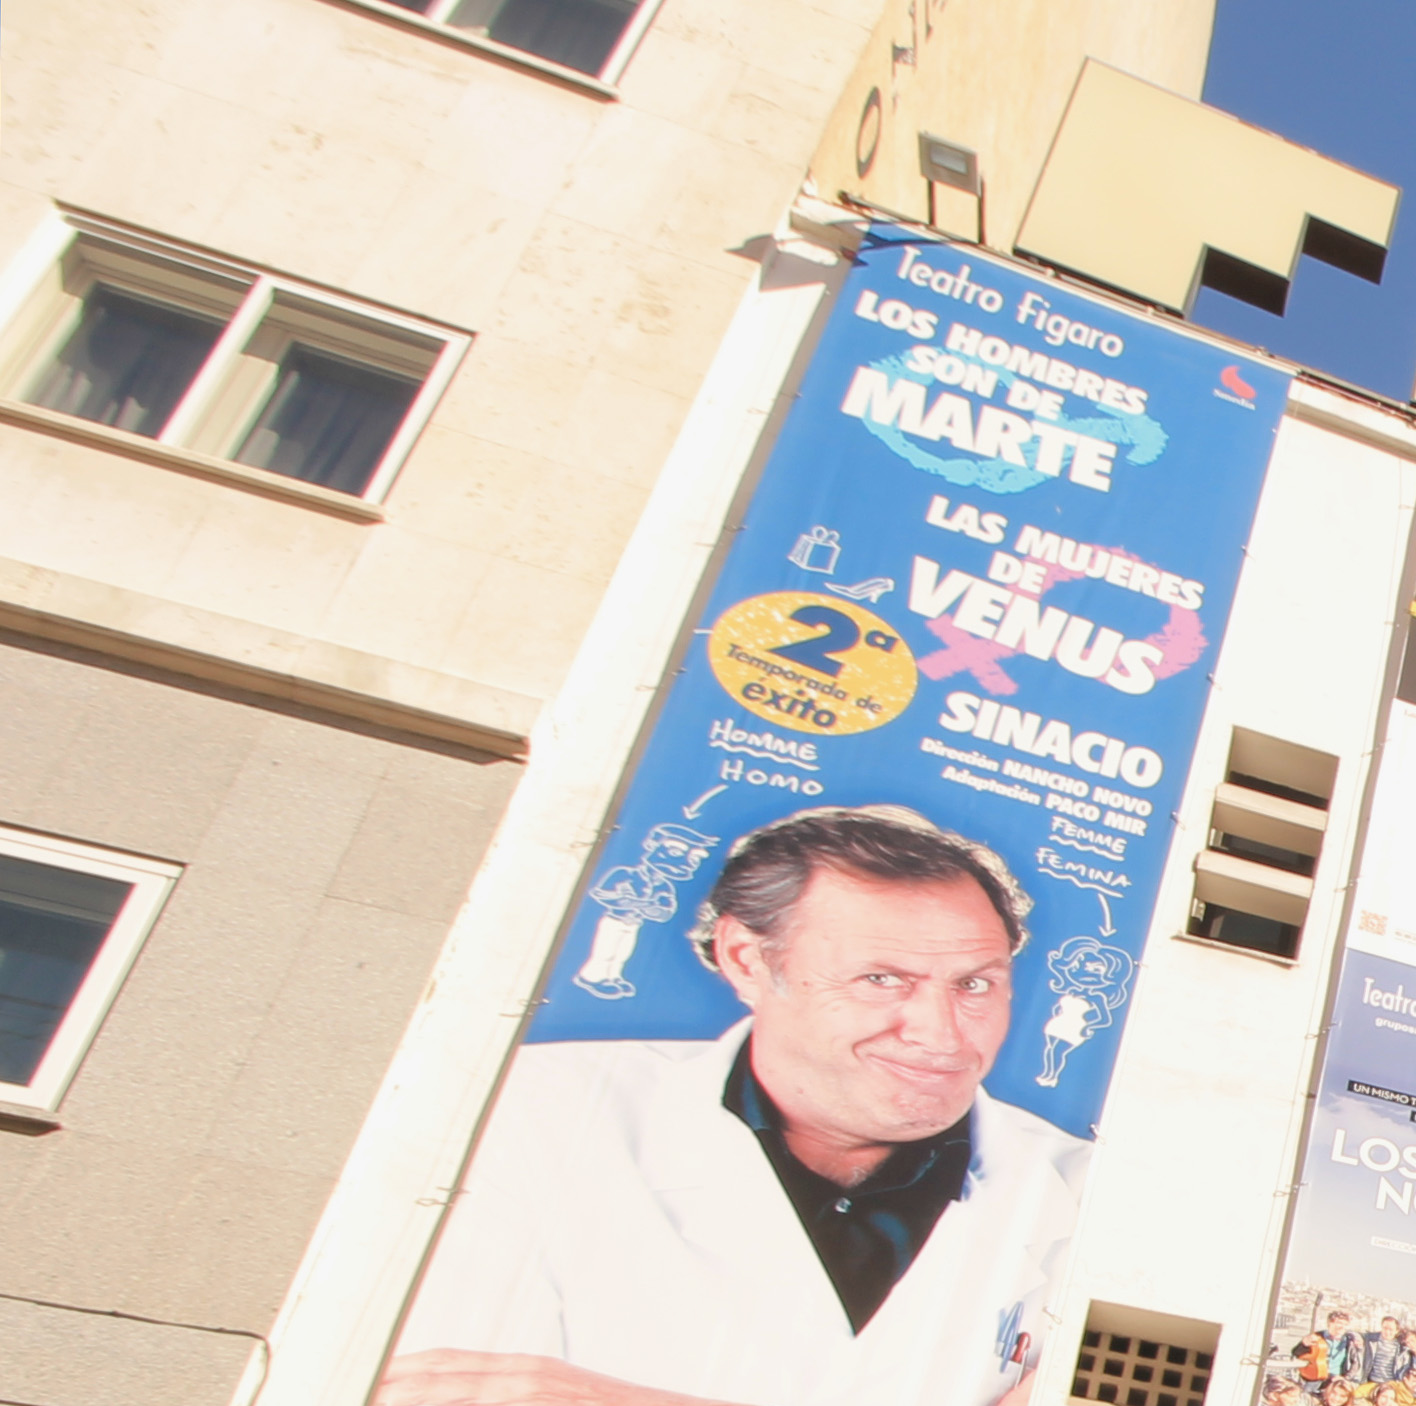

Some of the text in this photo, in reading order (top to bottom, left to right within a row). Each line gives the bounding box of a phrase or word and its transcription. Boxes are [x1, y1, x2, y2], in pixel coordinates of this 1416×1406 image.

[896, 246, 1123, 359] Teatro Figaro
[855, 290, 1148, 414] LOS HOMBRES
[906, 345, 1066, 420] SON DE
[840, 366, 1117, 492] MARTE
[926, 496, 1204, 610] LAS MUJERES
[988, 551, 1047, 594] DE
[908, 555, 1164, 694] VENUS
[726, 642, 884, 715] Temporada de
[741, 674, 837, 730] éxito
[920, 738, 1153, 817] Dirección NANCHO NOVO
[939, 692, 1162, 788] SINACIO
[942, 766, 1146, 836] Adaptación PACO MIR
[1051, 817, 1127, 854] FEMME
[1036, 848, 1131, 888] FEMINA
[1352, 1083, 1371, 1095] UN
[1371, 1087, 1409, 1104] MISMO
